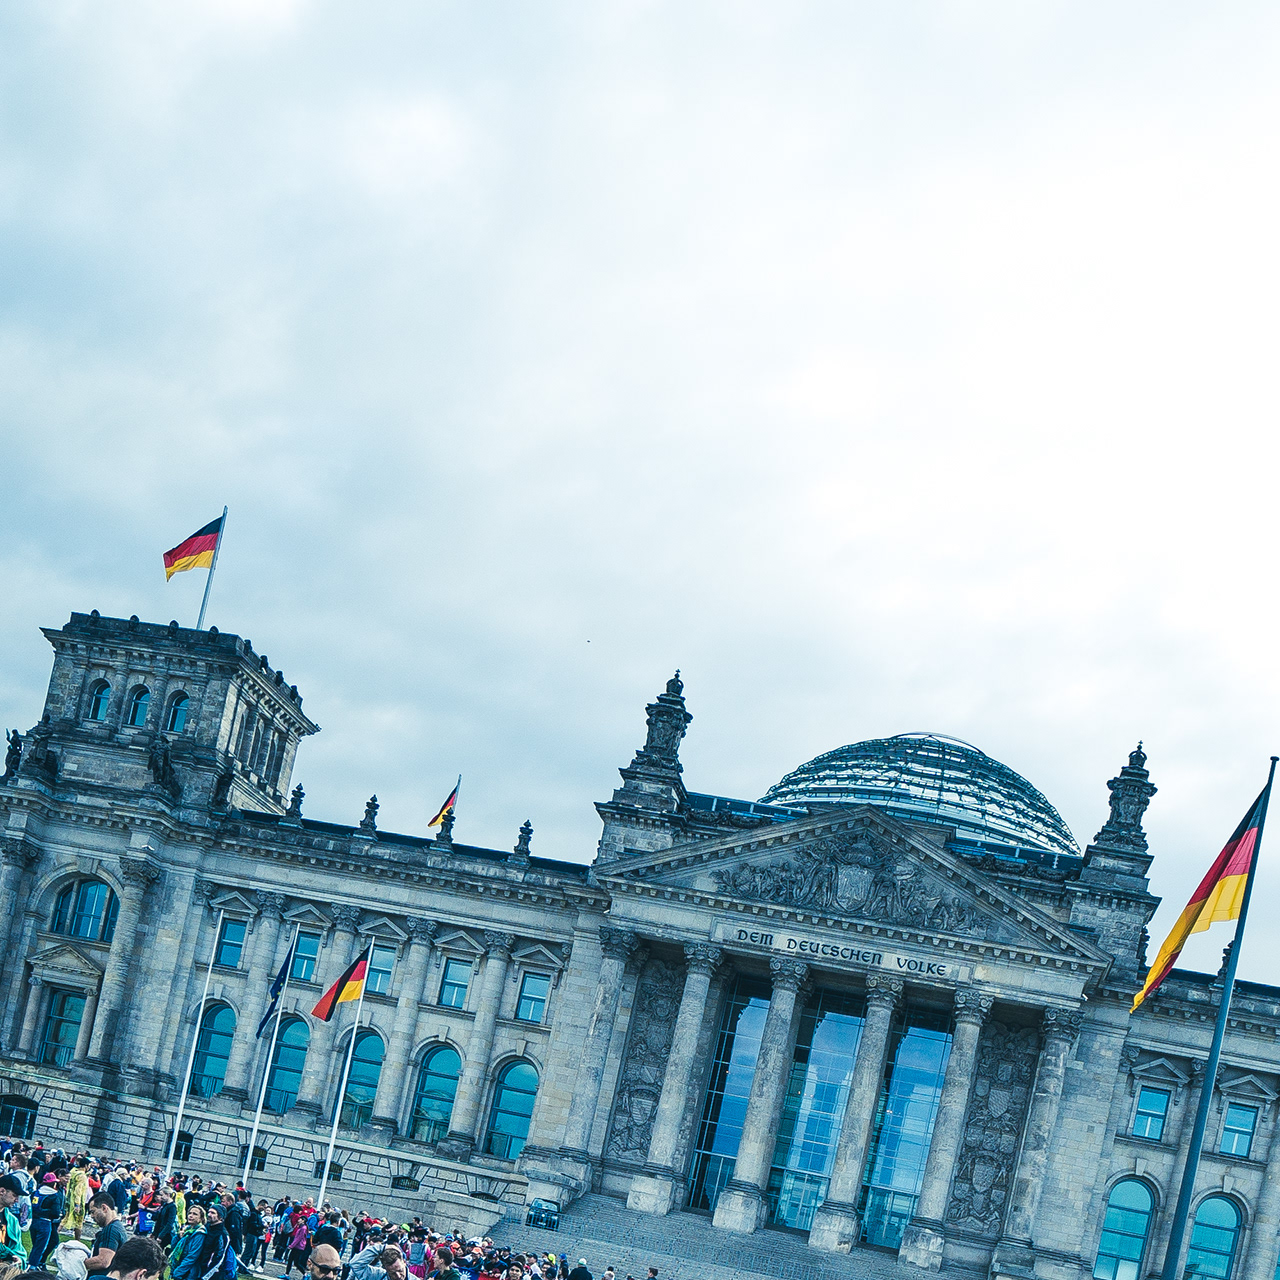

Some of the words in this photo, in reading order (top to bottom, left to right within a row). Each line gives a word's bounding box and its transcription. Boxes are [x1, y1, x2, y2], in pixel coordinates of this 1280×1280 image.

[737, 929, 773, 946] DEM
[786, 938, 882, 965] DEUTSCHEN
[896, 957, 947, 976] VOLKE
